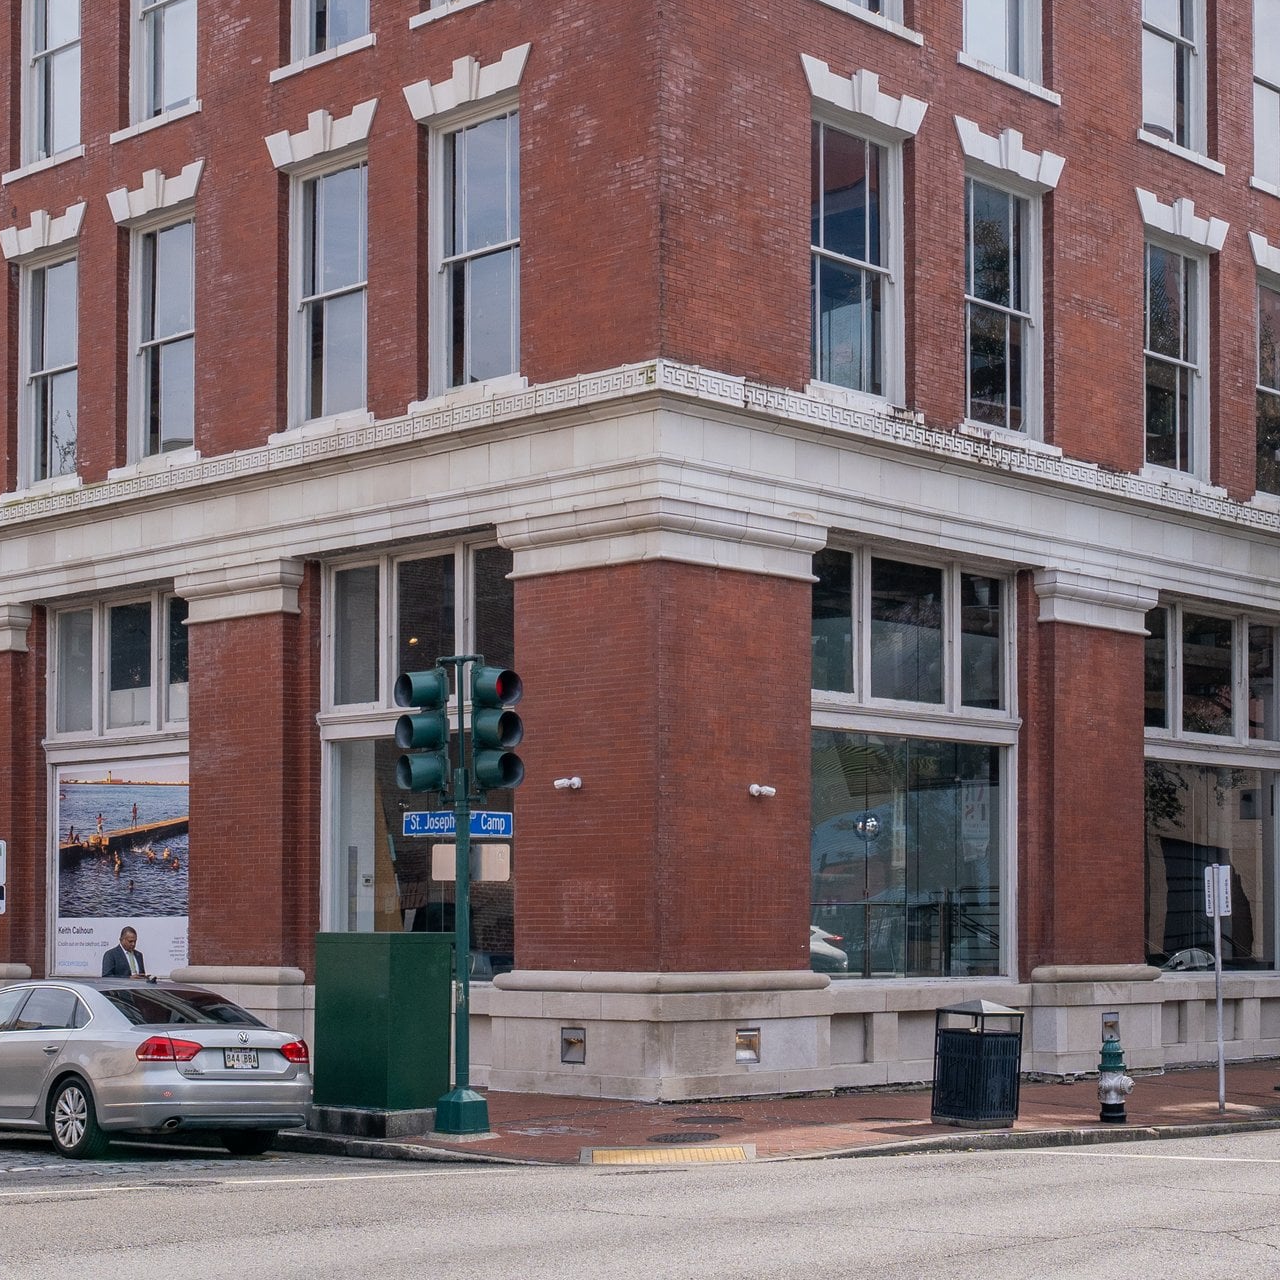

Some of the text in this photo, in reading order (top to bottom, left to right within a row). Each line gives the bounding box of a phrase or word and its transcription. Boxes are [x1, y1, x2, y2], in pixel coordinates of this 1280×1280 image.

[410, 814, 455, 832] St. Joseph
[480, 813, 506, 833] Camp
[58, 926, 94, 934] Keith Calhoun
